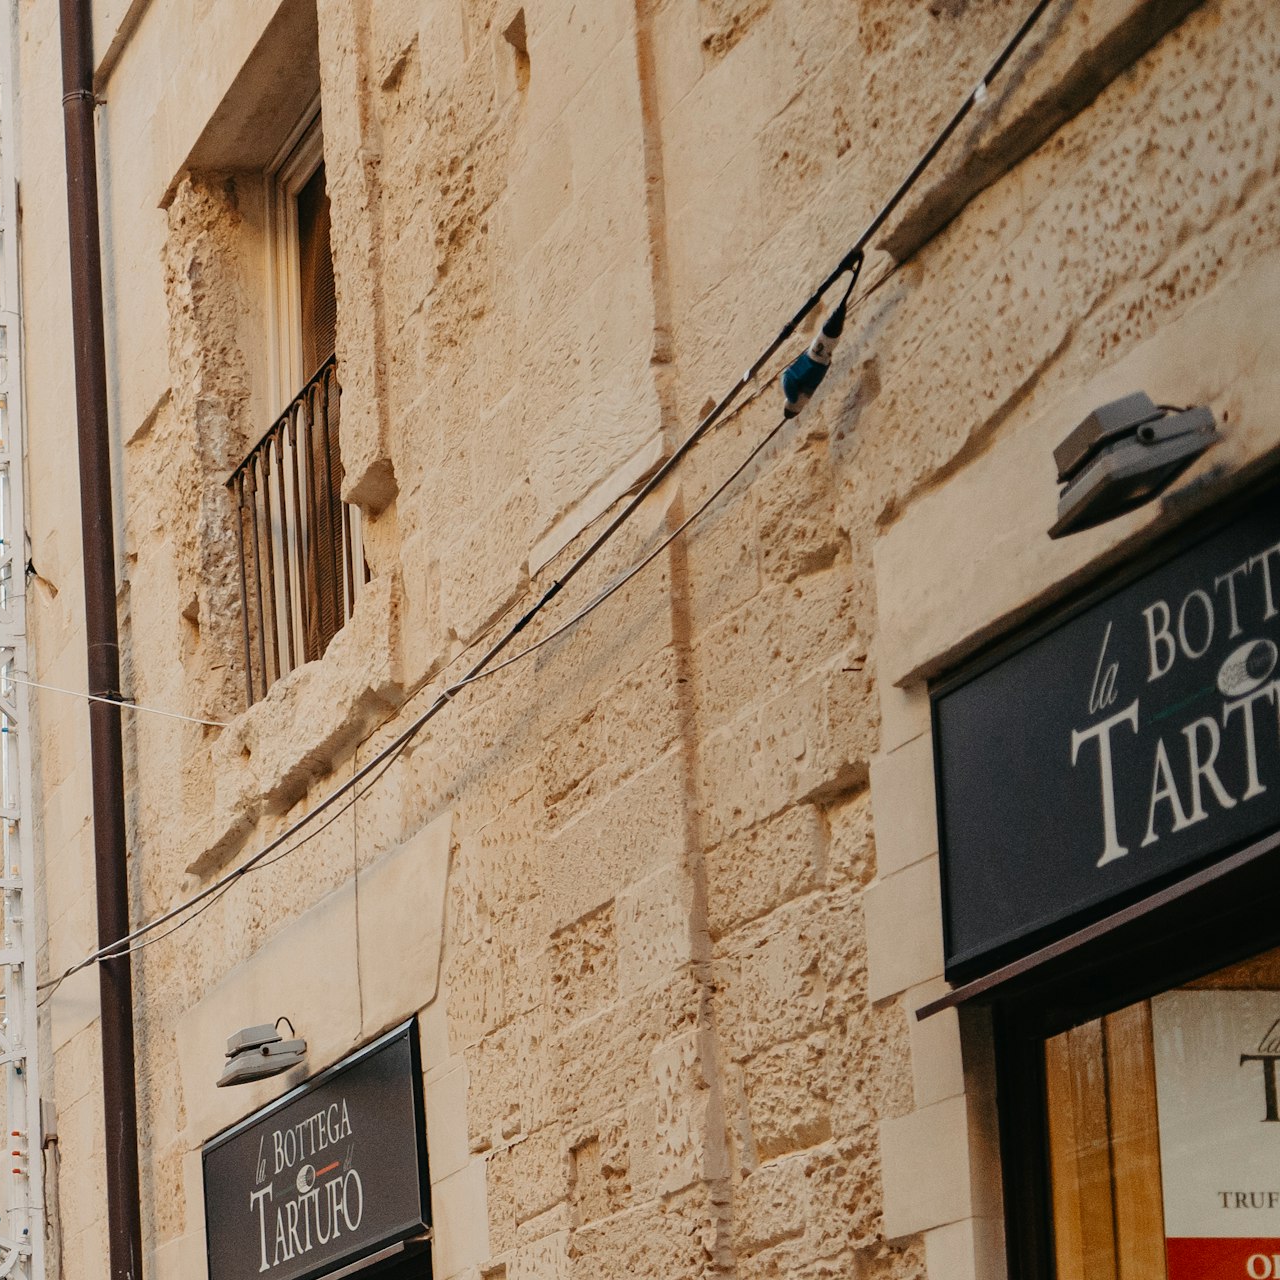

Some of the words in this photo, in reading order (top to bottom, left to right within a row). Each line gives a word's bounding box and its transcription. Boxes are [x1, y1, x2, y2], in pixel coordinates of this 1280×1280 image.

[1071, 679, 1280, 868] TART
[272, 1098, 352, 1175] BOTTEGA
[250, 1168, 363, 1273] TARTUFO
